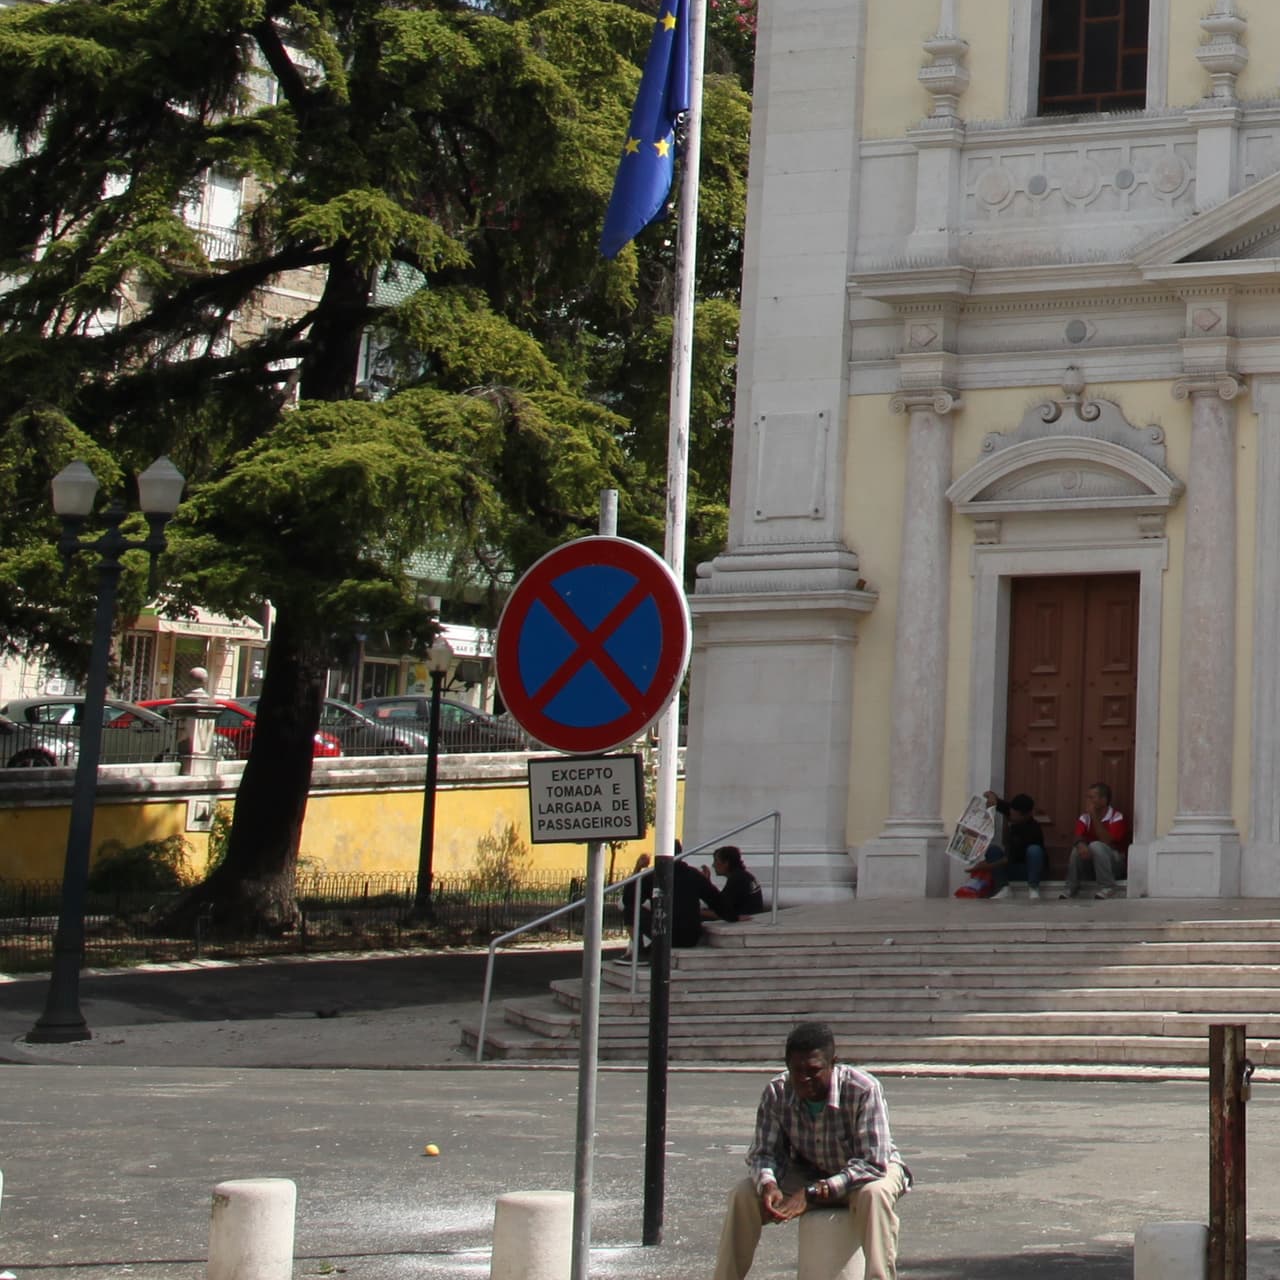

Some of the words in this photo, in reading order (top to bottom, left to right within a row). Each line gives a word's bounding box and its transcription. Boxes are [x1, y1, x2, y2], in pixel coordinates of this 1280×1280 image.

[552, 767, 613, 781] EXCEPTO
[546, 784, 602, 797] TOMADA
[612, 783, 621, 795] E
[538, 801, 602, 815] LARGADA
[612, 799, 630, 812] DE
[538, 816, 632, 831] PASSAGEIROS
